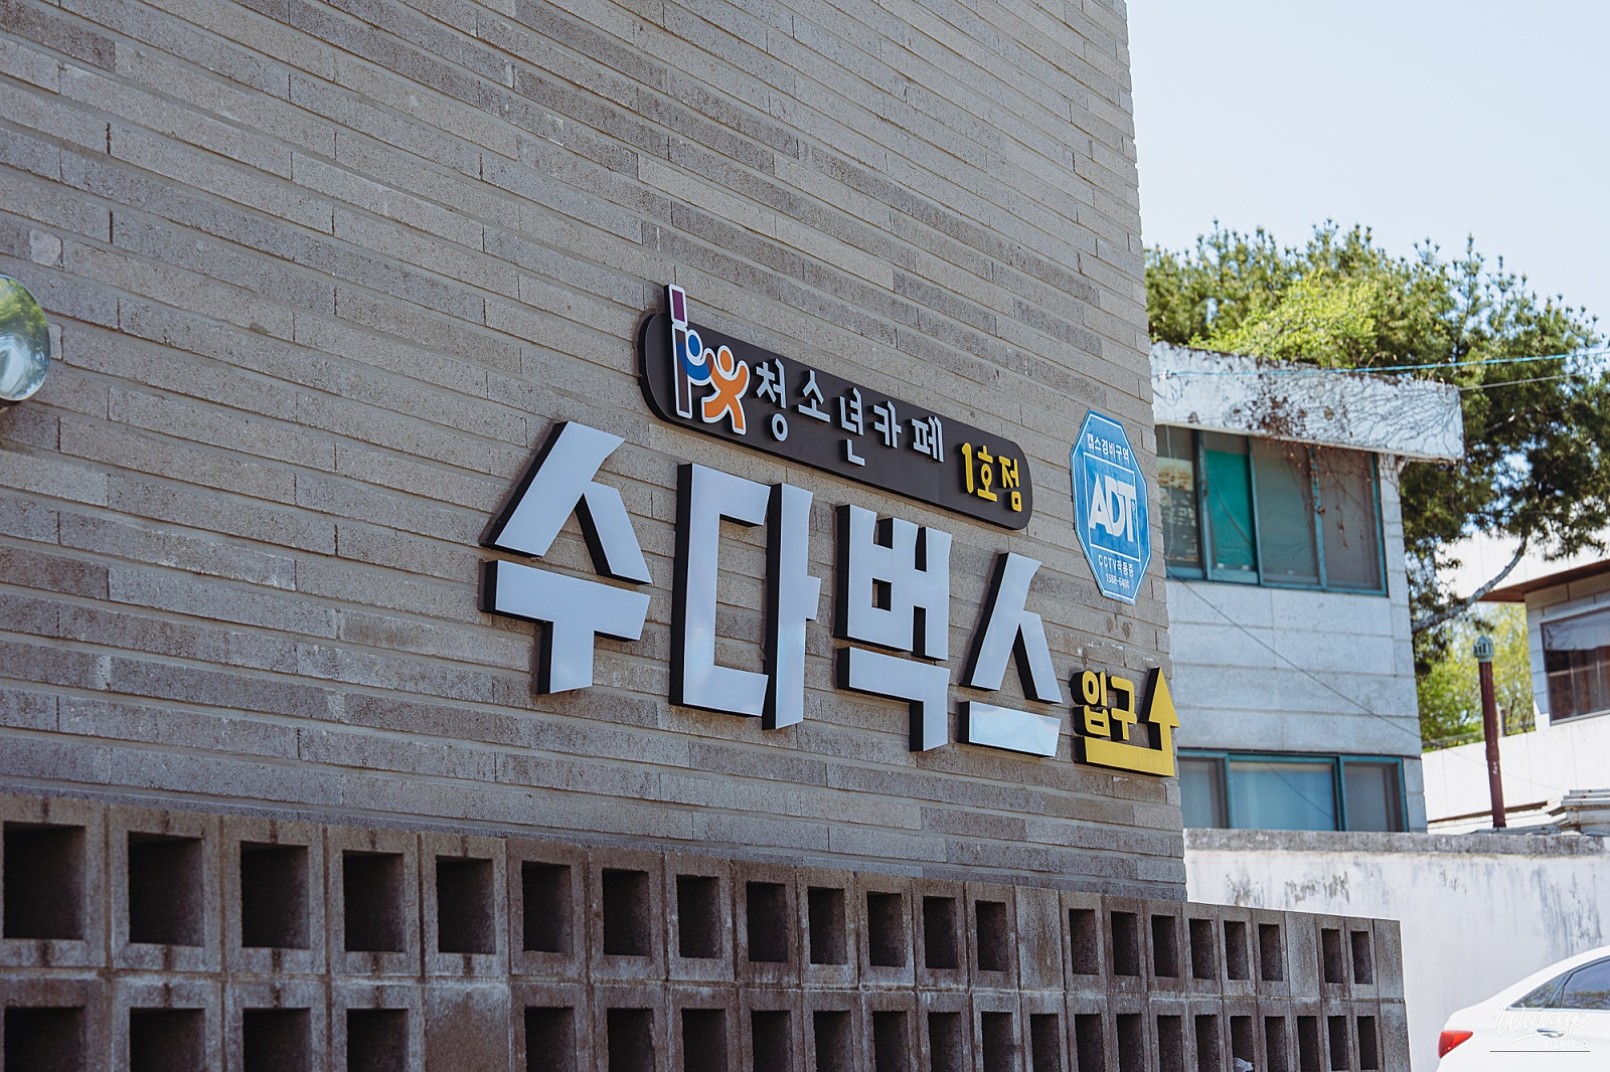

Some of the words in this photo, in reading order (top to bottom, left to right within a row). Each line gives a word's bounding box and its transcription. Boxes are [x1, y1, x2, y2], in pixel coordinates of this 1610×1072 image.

[757, 358, 944, 466] 청소년카페
[962, 442, 1022, 512] 1호점
[1087, 433, 1129, 464] 캡스경비구역
[1089, 474, 1136, 542] ADT
[494, 421, 1062, 757] 수다벅스
[1082, 670, 1138, 741] 입구
